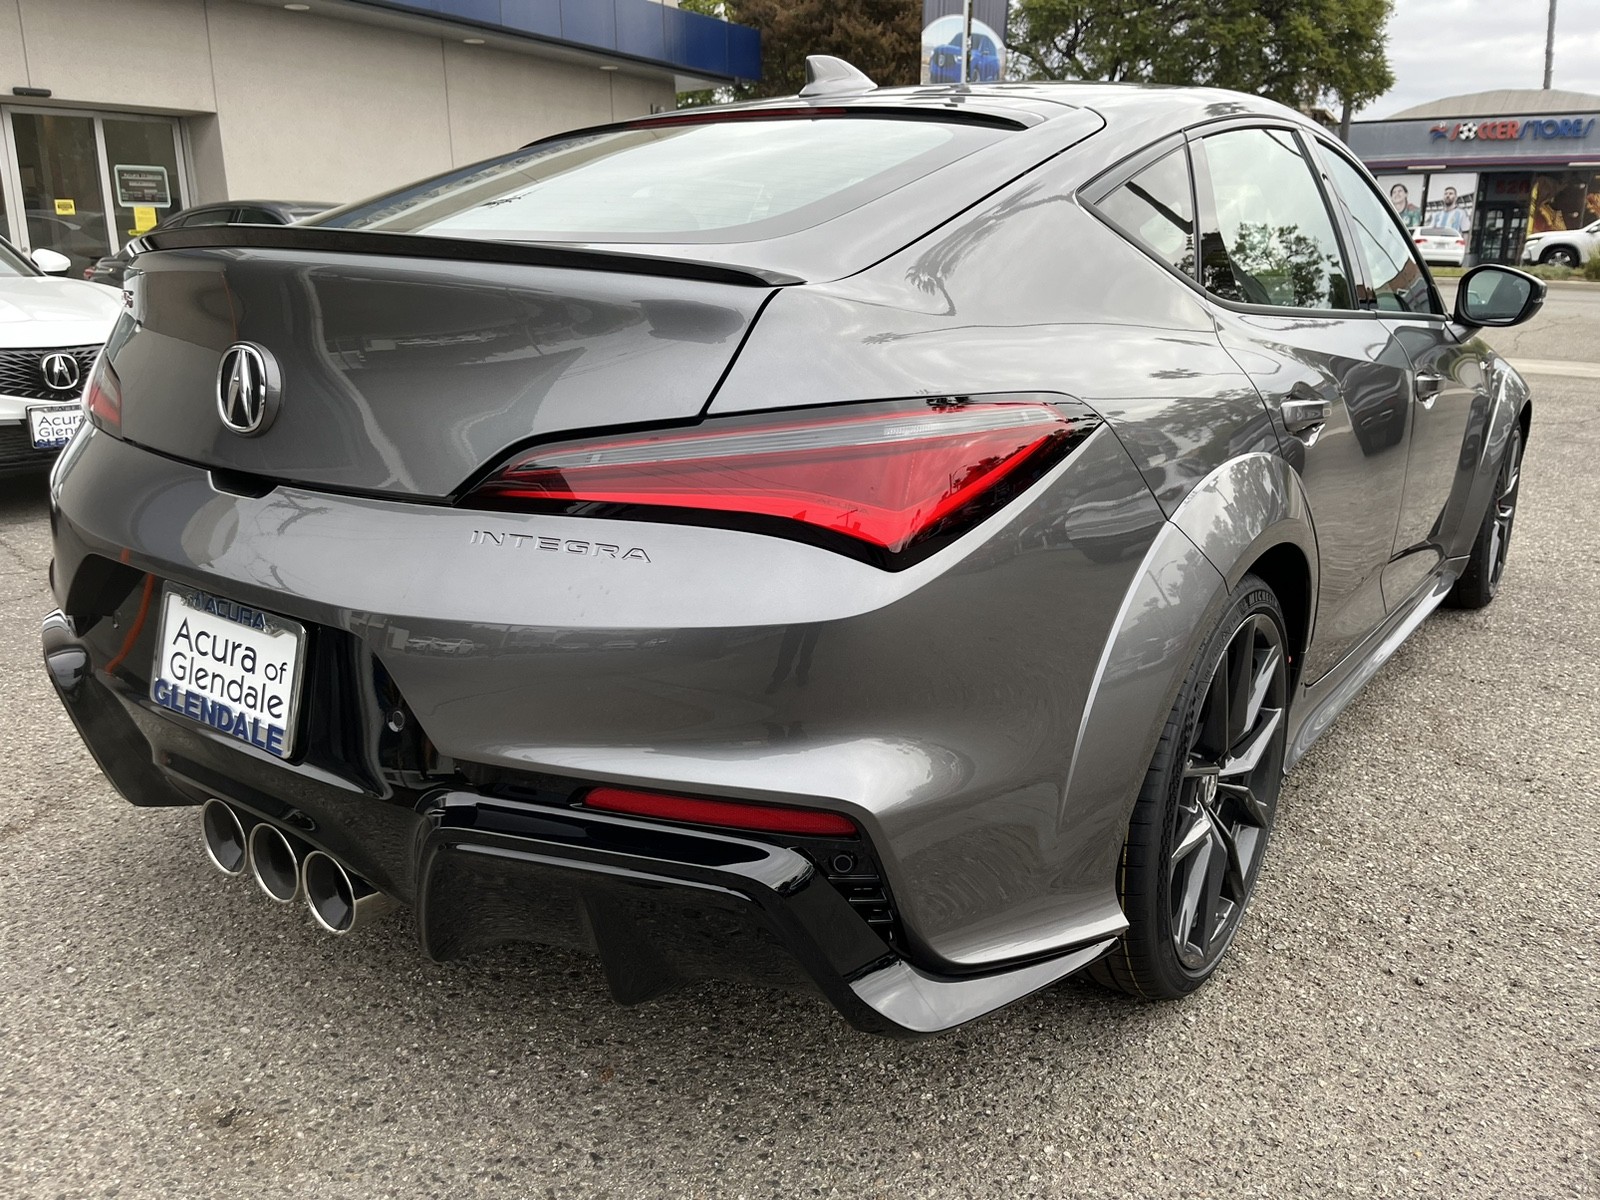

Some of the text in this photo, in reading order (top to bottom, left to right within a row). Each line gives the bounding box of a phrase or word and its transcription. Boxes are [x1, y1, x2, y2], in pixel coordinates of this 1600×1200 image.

[470, 530, 652, 564] INTEGRA
[204, 597, 266, 631] ACURA
[172, 616, 288, 685] Acura of
[154, 678, 285, 756] GLENDALE
[170, 651, 284, 719] Glendale
